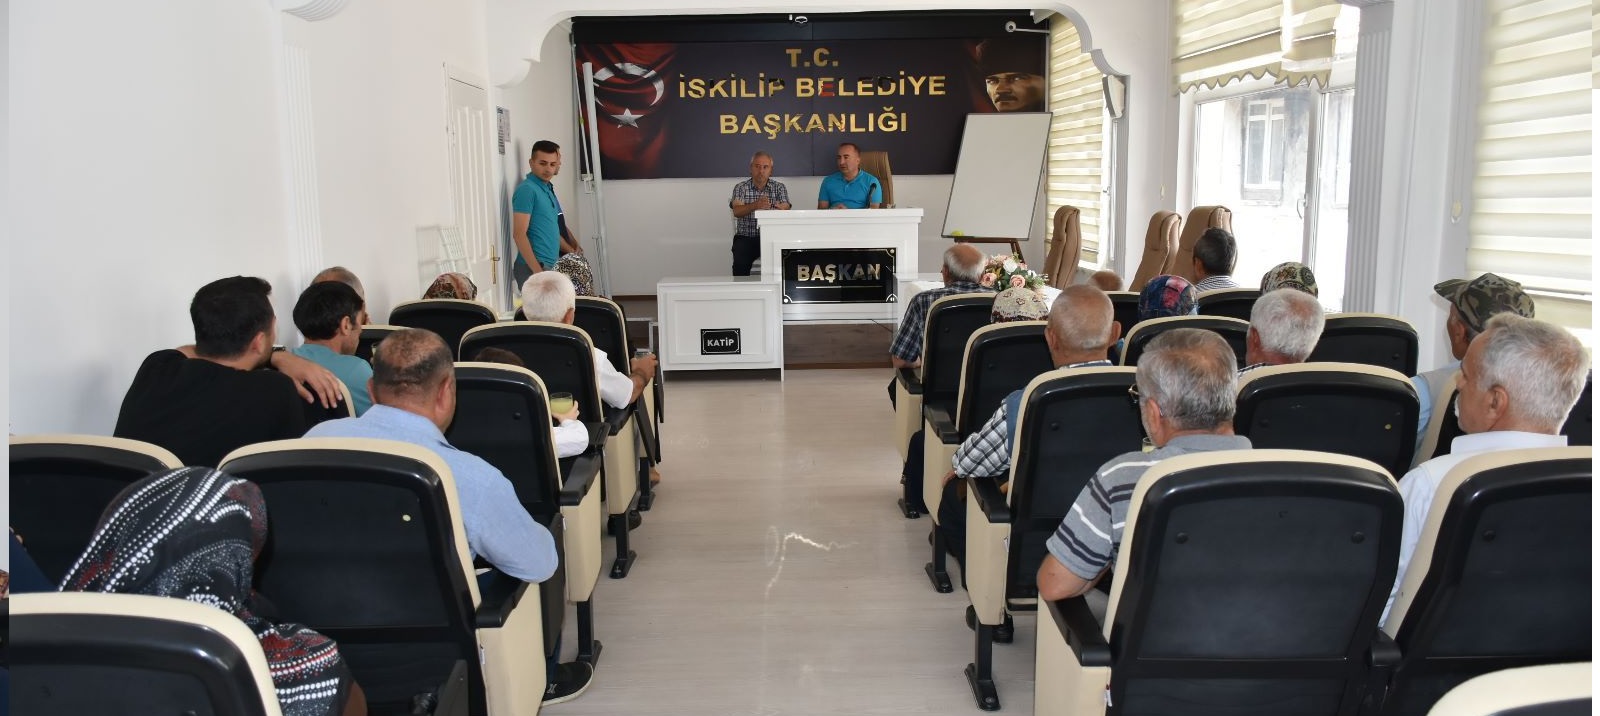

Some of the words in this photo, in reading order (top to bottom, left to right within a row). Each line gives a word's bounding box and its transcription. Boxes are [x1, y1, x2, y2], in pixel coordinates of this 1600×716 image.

[785, 47, 839, 67] T.C.
[679, 73, 785, 98] İSKİLİP
[796, 70, 946, 98] BELEDİYE
[719, 106, 907, 140] BAŞKANLIĞI
[797, 263, 881, 283] BAŞKAN
[707, 336, 735, 347] KATİP
